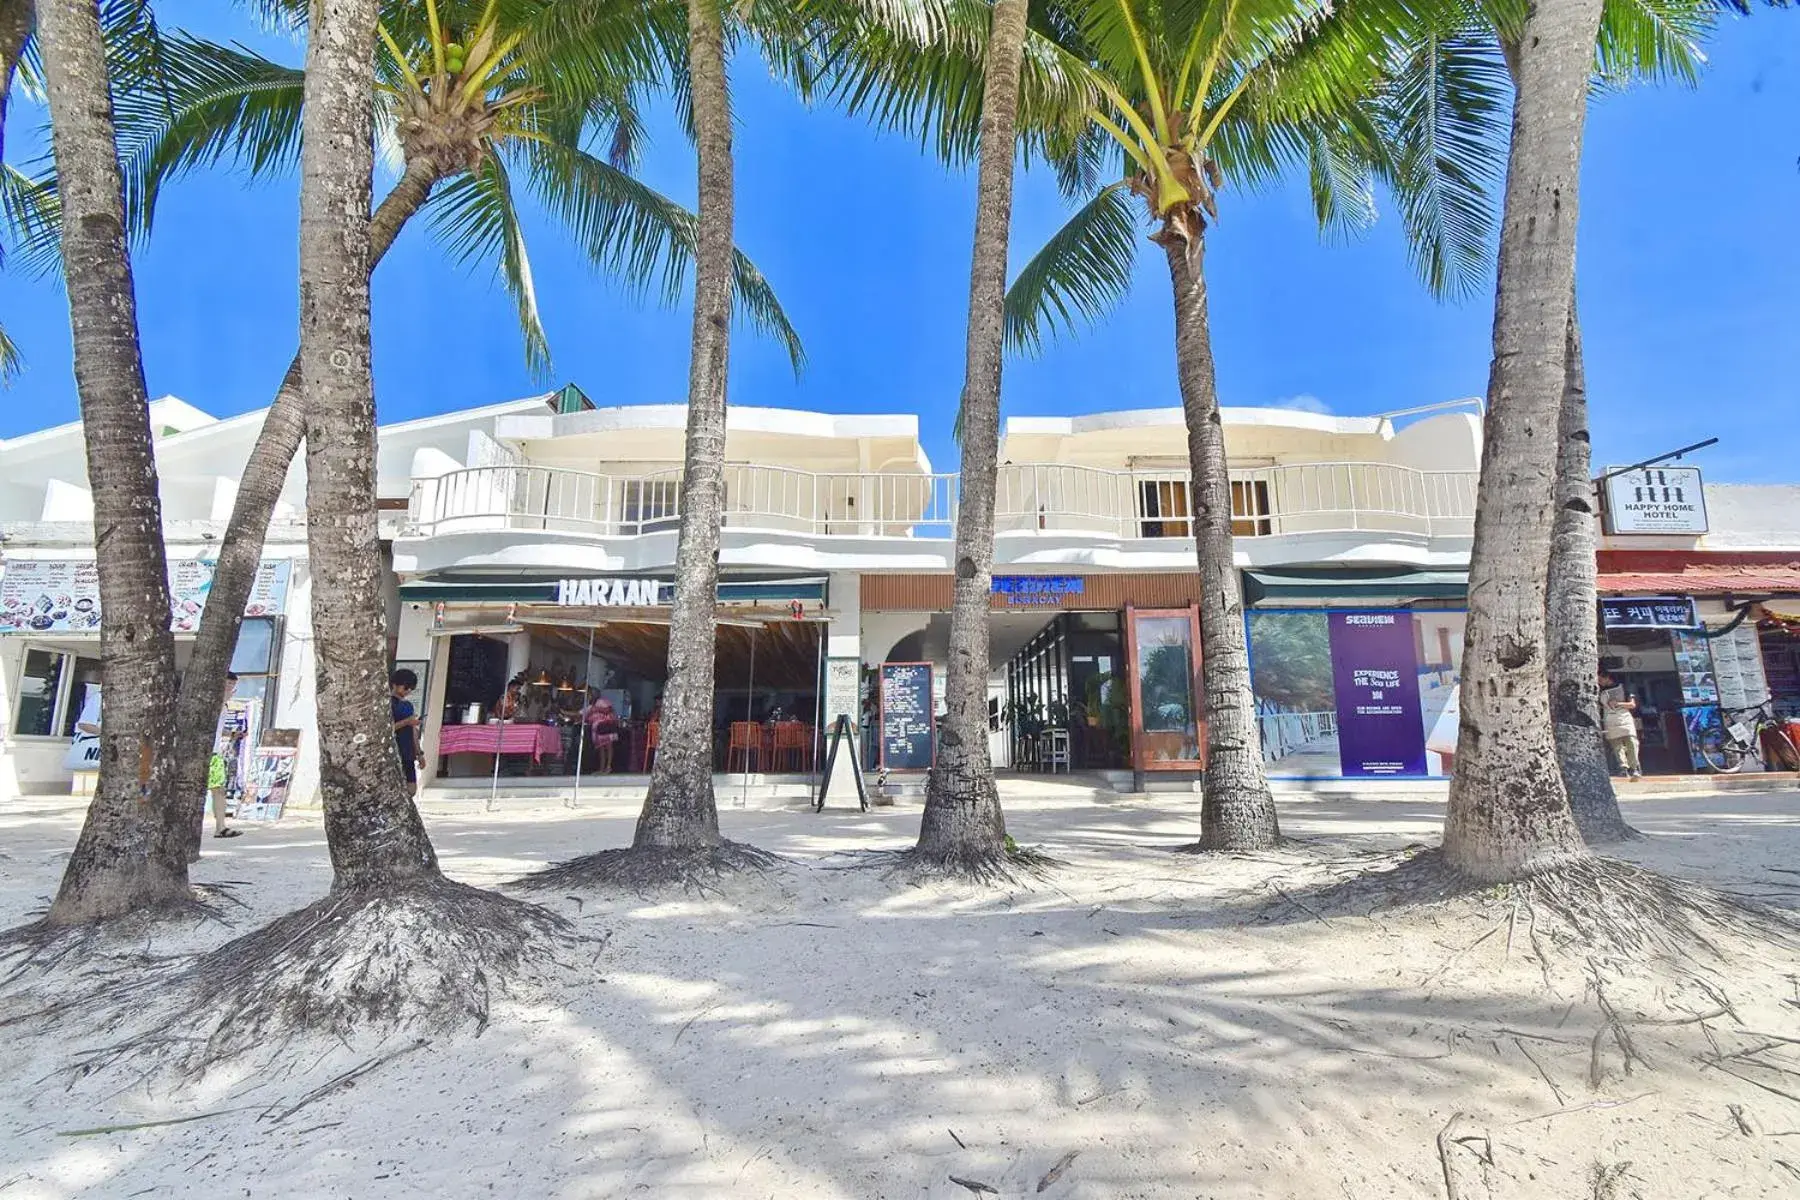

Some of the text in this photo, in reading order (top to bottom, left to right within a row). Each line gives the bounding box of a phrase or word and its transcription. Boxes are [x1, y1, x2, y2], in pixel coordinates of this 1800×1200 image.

[1624, 503, 1696, 512] HAPPY HOME
[1643, 511, 1679, 519] HOTEL
[558, 579, 659, 606] HARAAN
[1353, 670, 1400, 680] EXPERIENCE
[1385, 679, 1401, 688] LIFE
